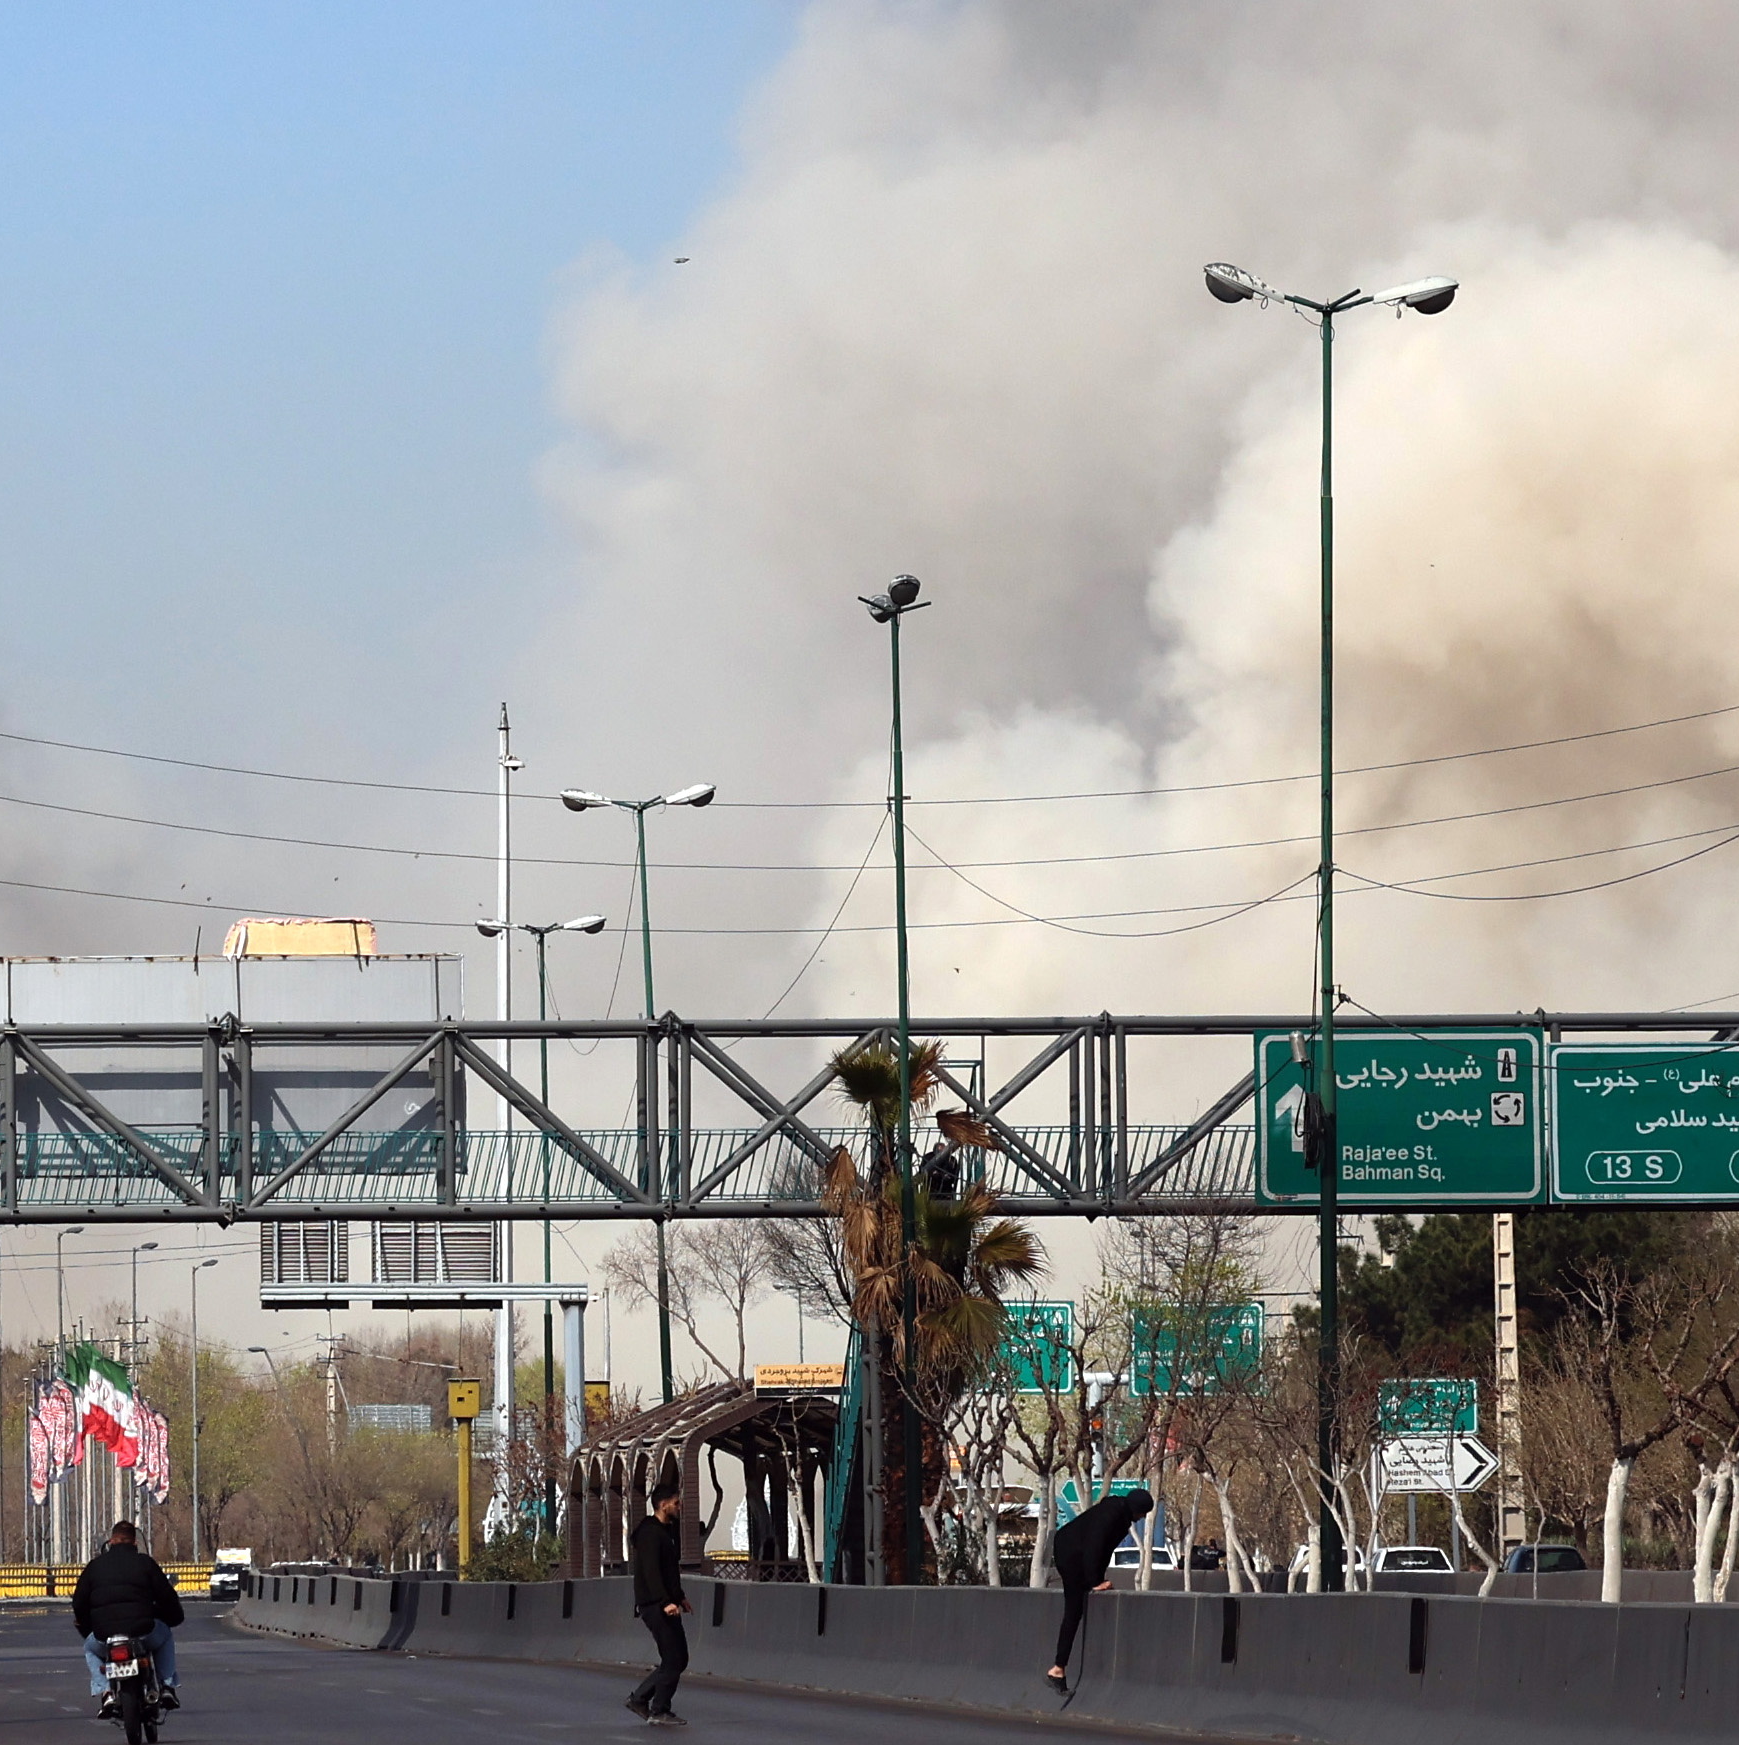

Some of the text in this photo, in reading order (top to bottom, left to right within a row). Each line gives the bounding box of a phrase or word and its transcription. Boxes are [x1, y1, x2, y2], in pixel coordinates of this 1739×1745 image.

[1335, 1055, 1482, 1090] شهید رجایی
[1573, 1069, 1639, 1096] جنوب
[1416, 1106, 1482, 1130] بهمن
[1636, 1109, 1707, 1134] سلامی
[1342, 1145, 1438, 1163] Raja'ee St.
[1342, 1165, 1446, 1182] Bahman Sq.
[1603, 1155, 1663, 1179] 13 S
